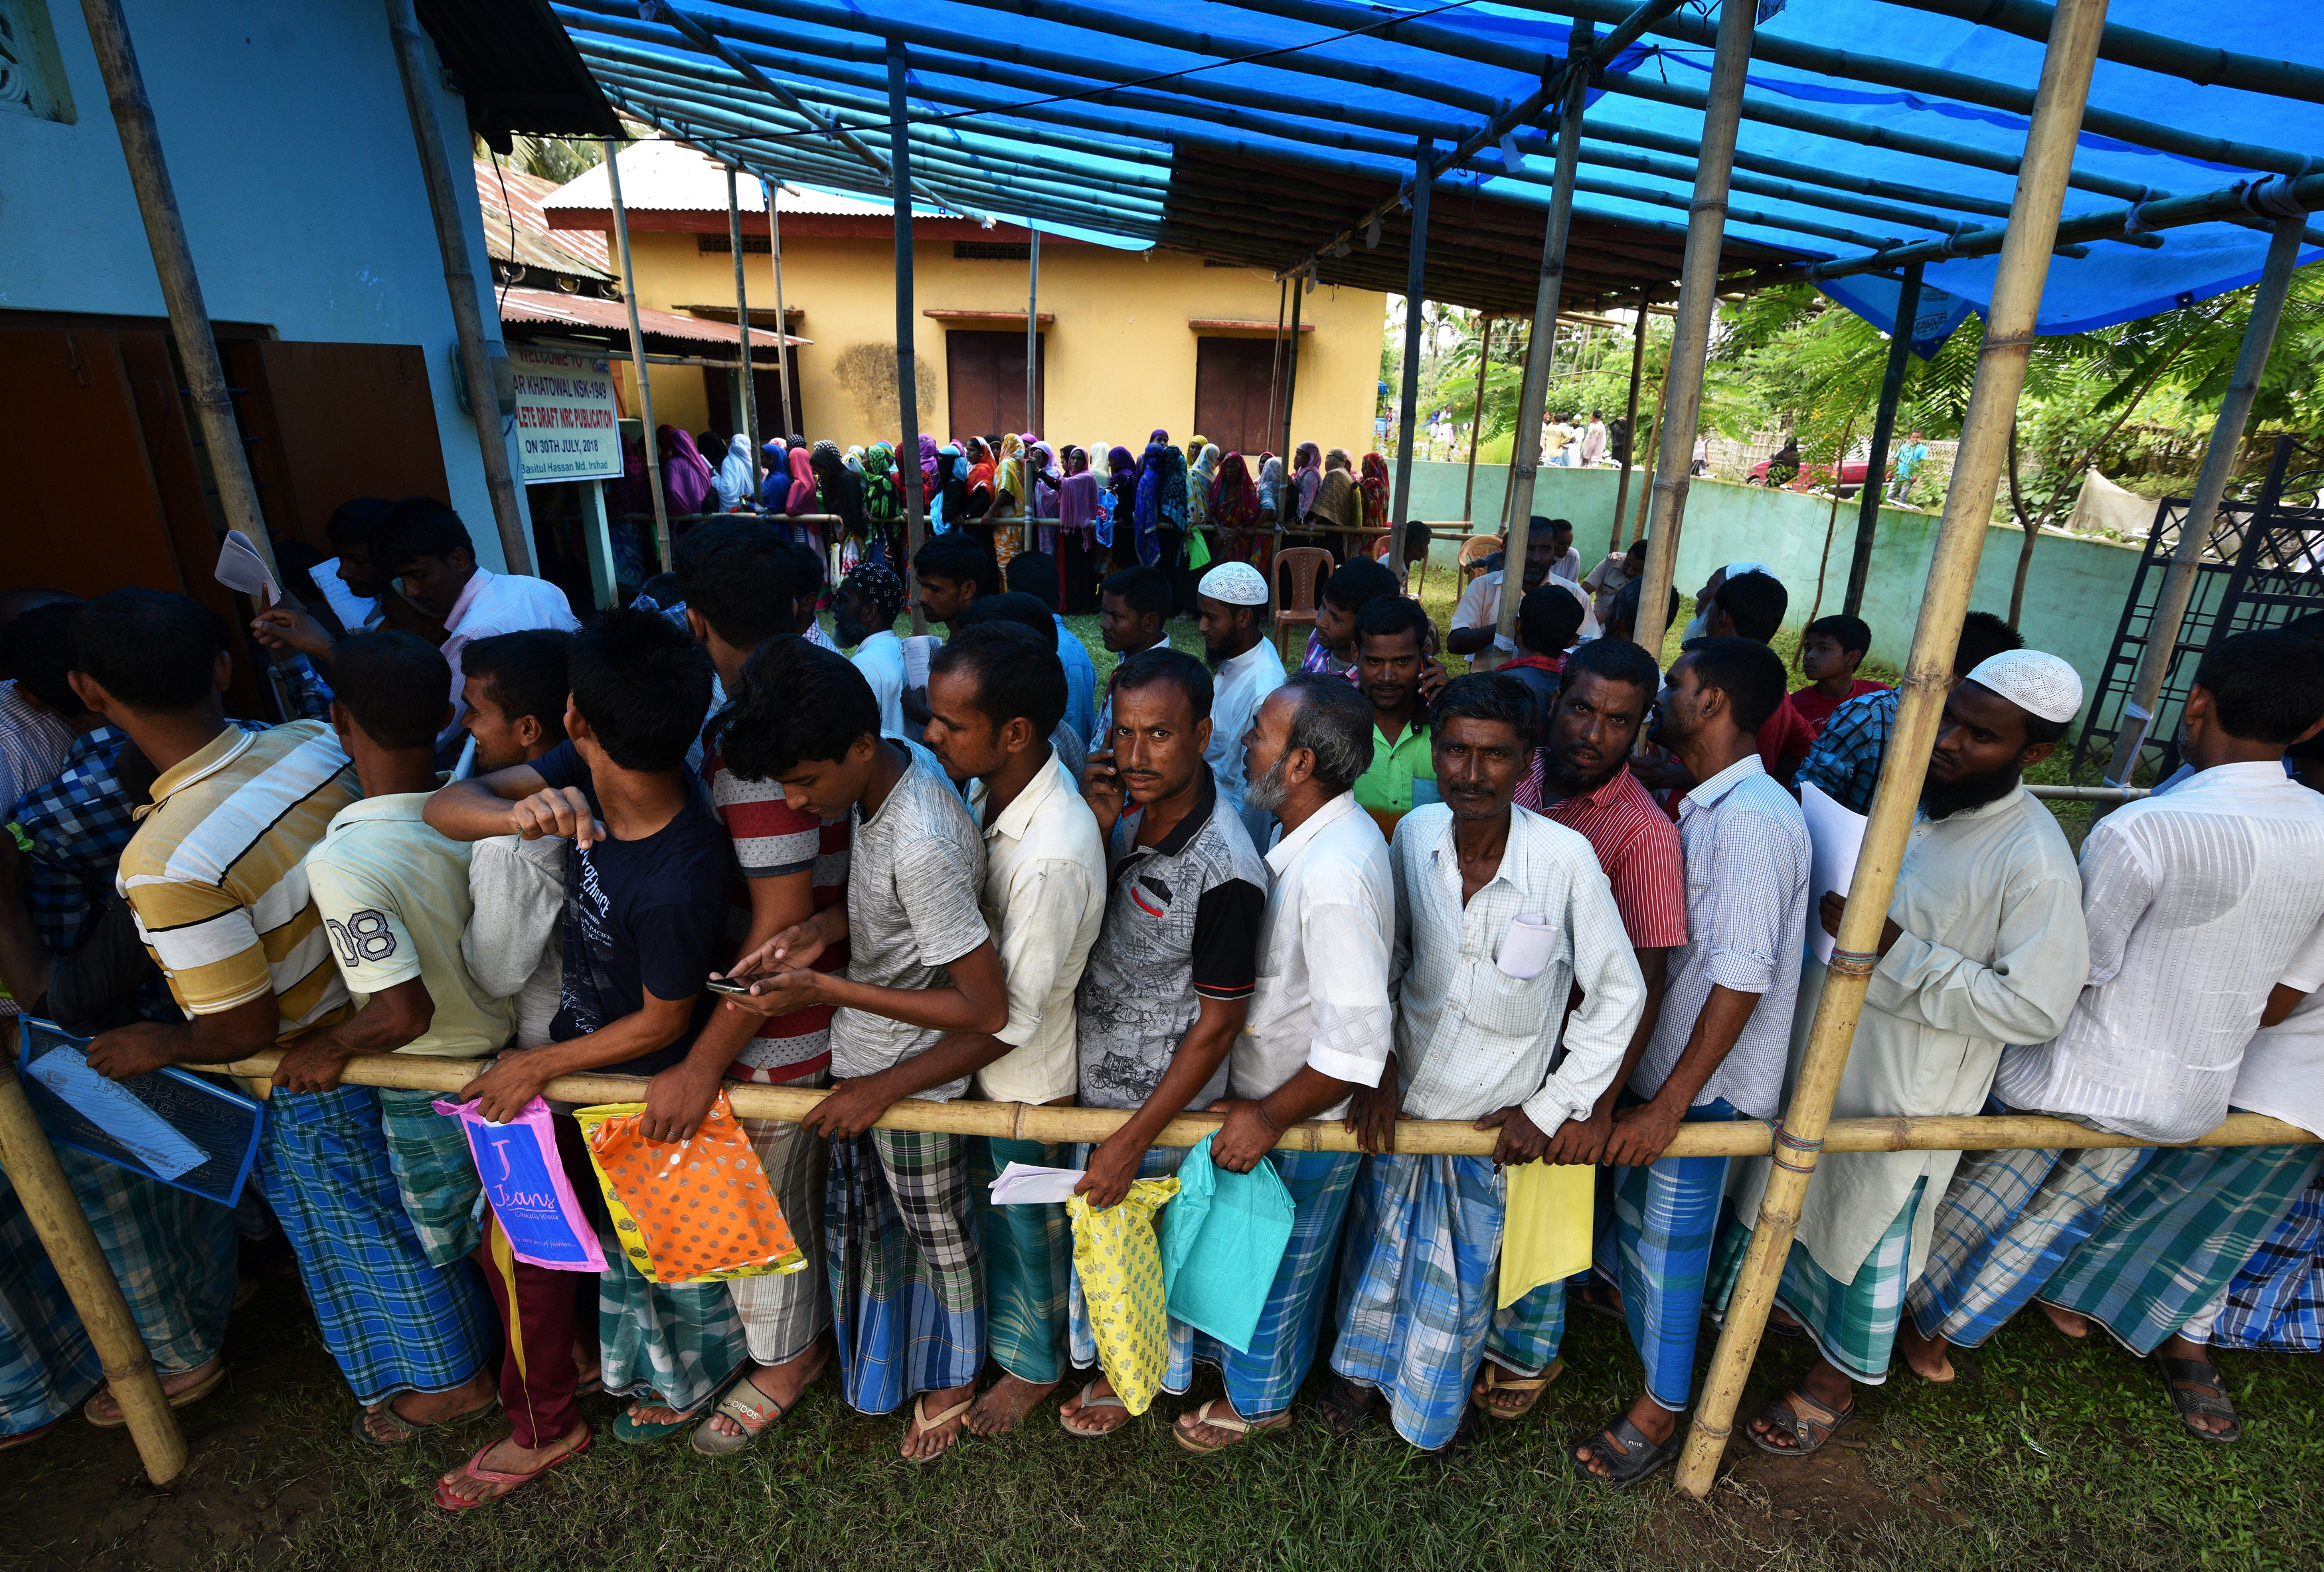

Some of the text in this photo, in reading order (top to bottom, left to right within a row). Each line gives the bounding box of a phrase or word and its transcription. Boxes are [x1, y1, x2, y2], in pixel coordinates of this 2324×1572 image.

[519, 350, 569, 366] WELCOME
[527, 376, 573, 398] KHATOWAL
[573, 378, 607, 399] NSK-1949
[536, 406, 560, 428] DRAFT
[559, 407, 574, 429] NRC
[574, 408, 614, 429] PUBLICATION
[525, 439, 599, 455] ON 30TH JULY, 2018
[548, 463, 574, 473] Hassan
[575, 461, 588, 471] Md.
[588, 460, 608, 470] Irshad
[491, 1139, 511, 1181] J
[493, 1184, 555, 1208] Jeans
